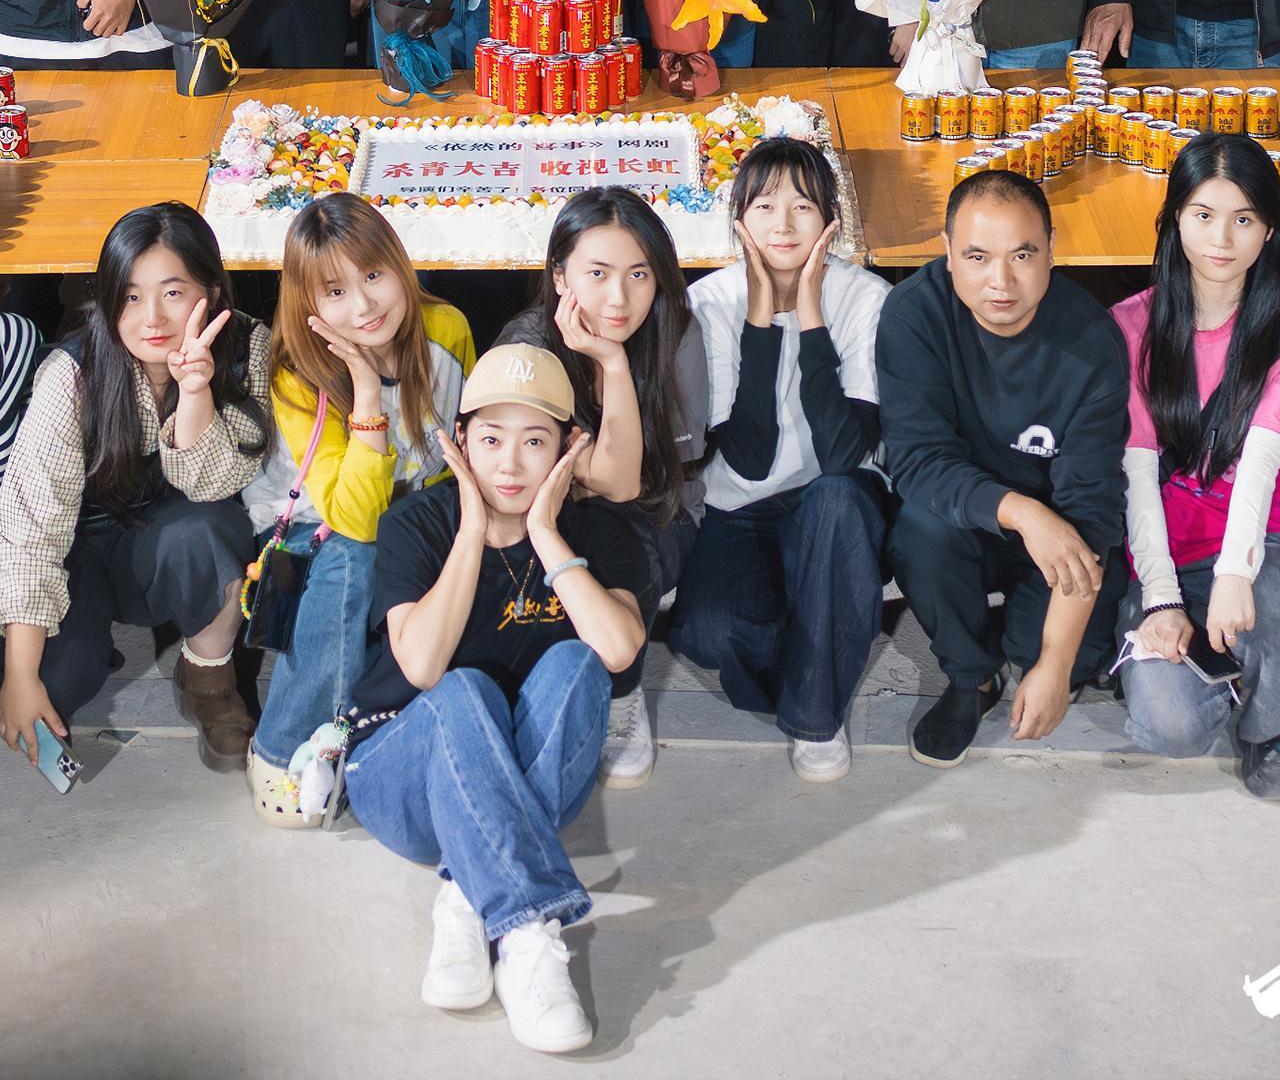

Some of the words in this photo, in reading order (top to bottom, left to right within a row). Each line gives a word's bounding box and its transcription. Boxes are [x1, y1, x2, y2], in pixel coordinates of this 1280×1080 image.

[516, 71, 528, 110] 王老吉
[552, 71, 564, 110] 王老吉
[587, 71, 599, 110] 王老吉
[382, 160, 521, 178] 杀青大吉
[540, 157, 681, 177] 收视长虹
